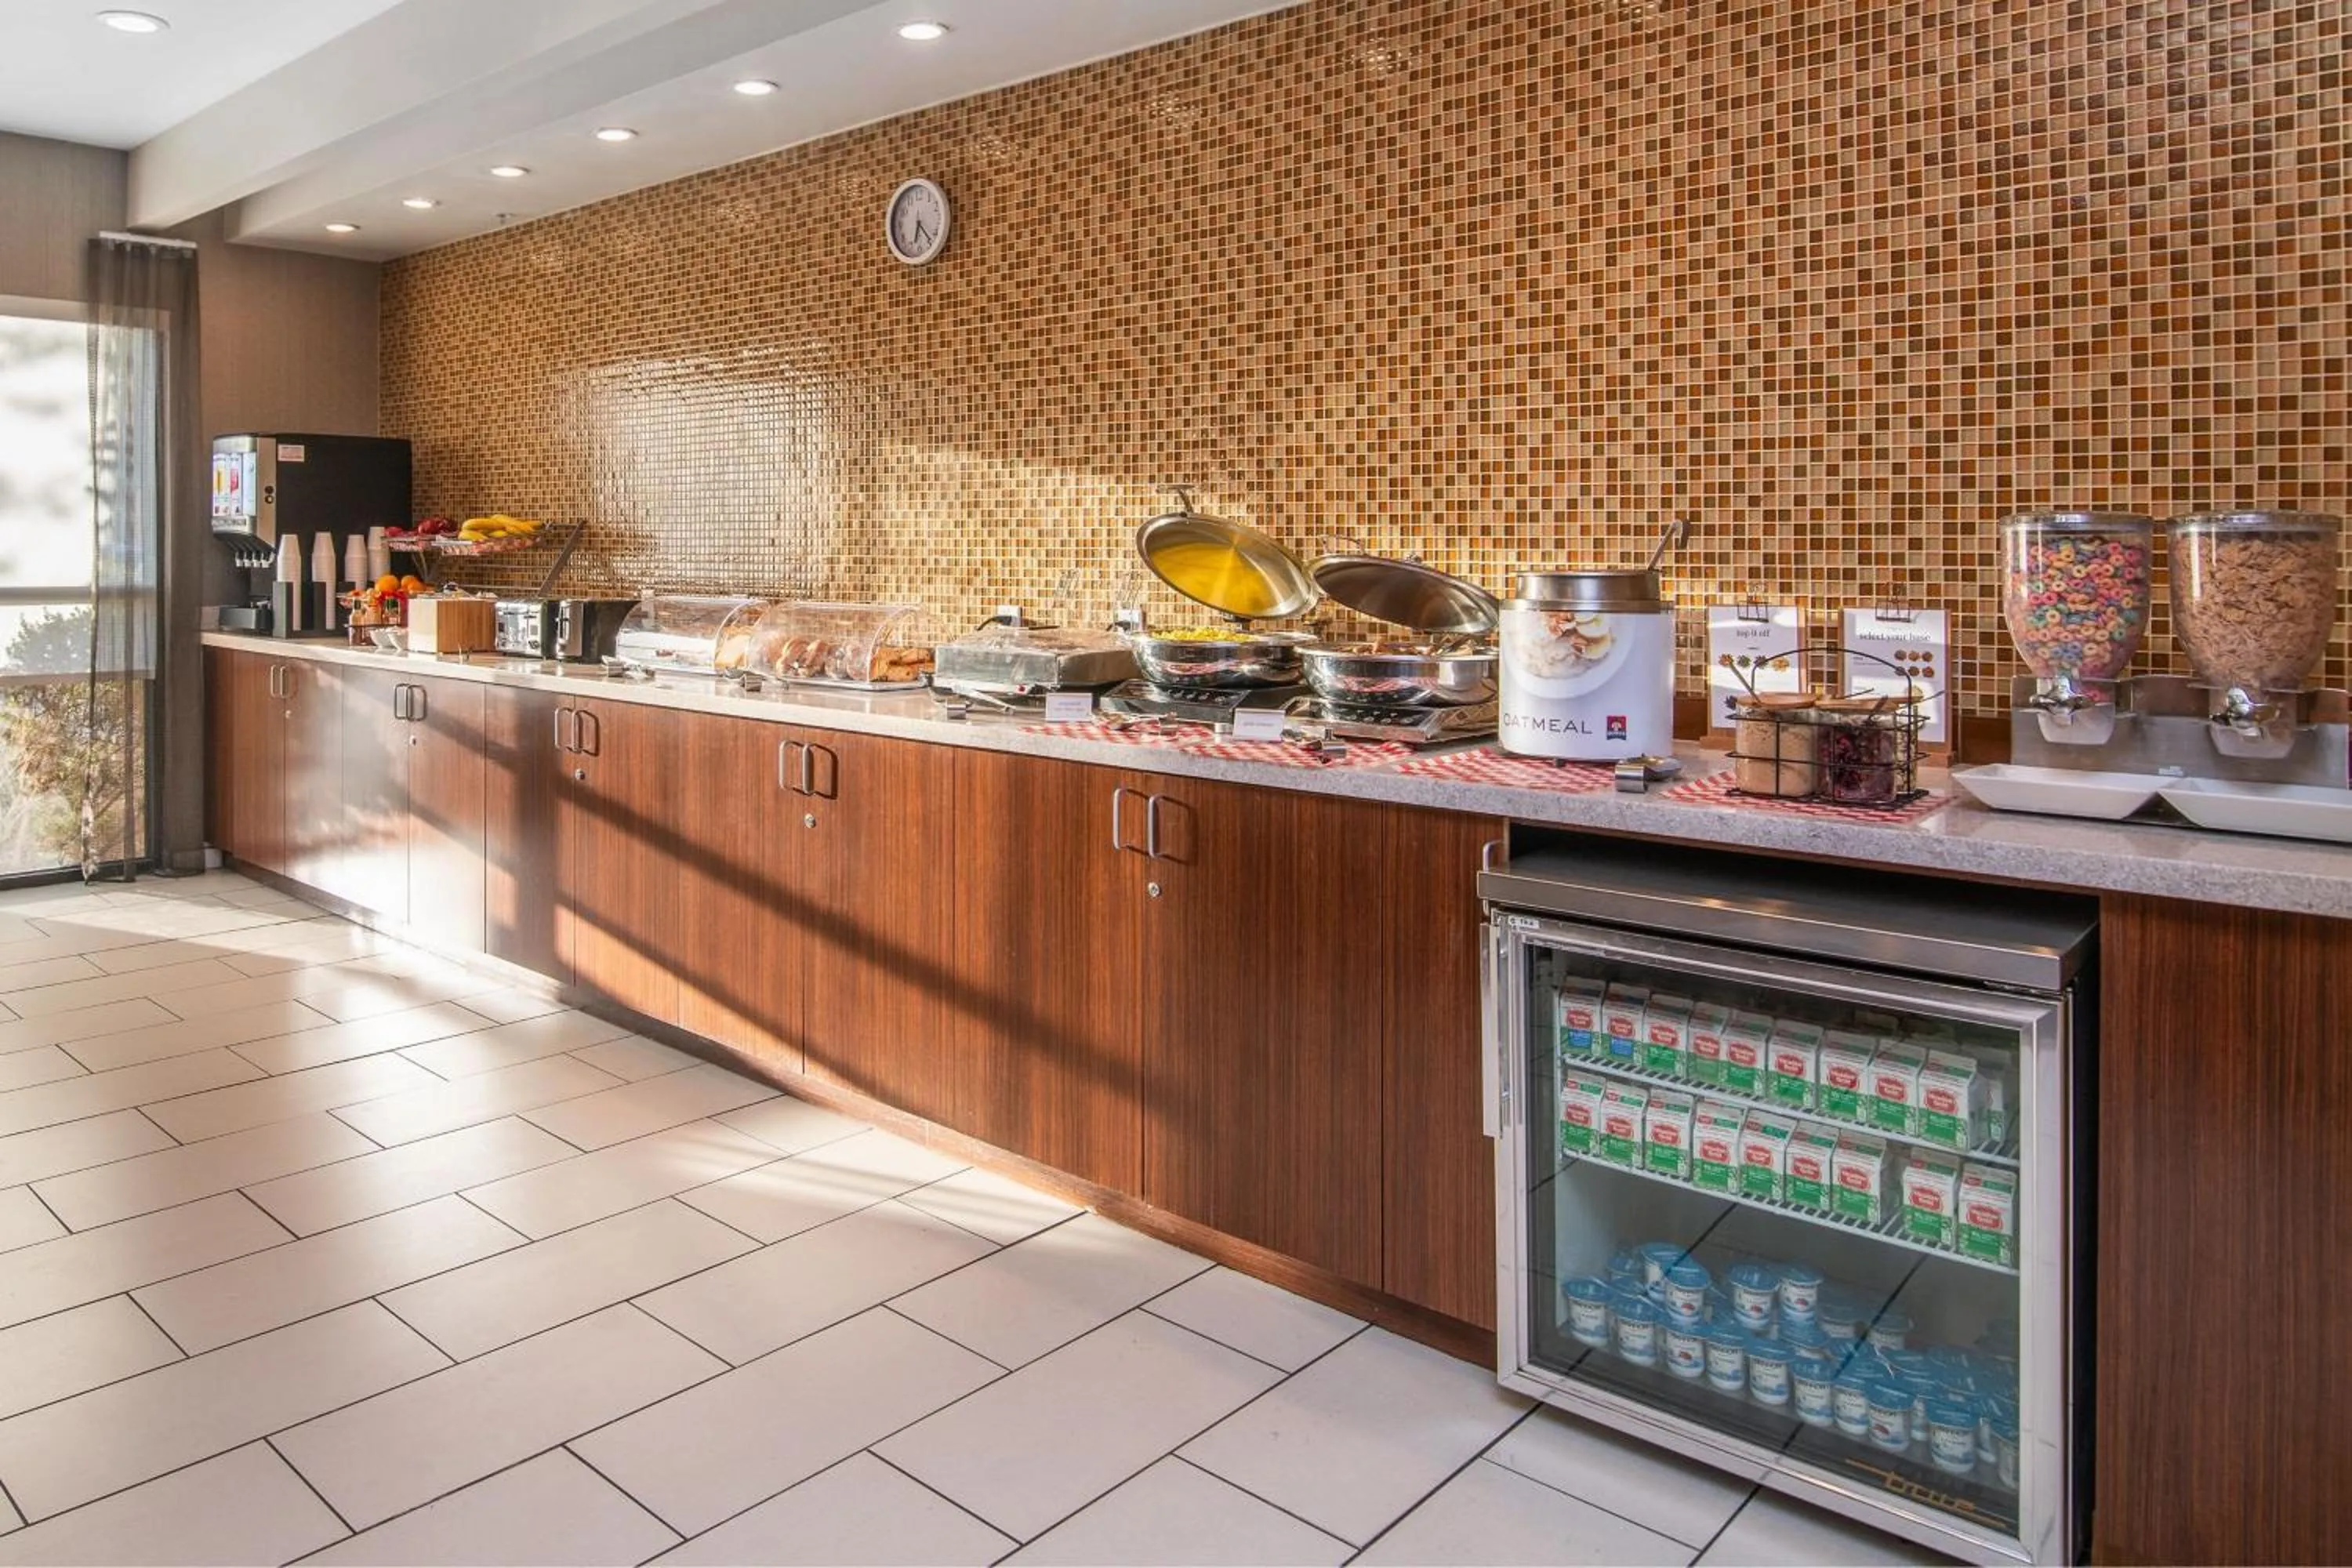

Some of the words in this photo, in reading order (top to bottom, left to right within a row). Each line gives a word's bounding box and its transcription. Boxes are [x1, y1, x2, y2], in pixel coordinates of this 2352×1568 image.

[1859, 631, 1885, 641] select
[1886, 633, 1907, 642] your
[1909, 632, 1931, 641] base
[1503, 713, 1593, 735] OATMEAL
